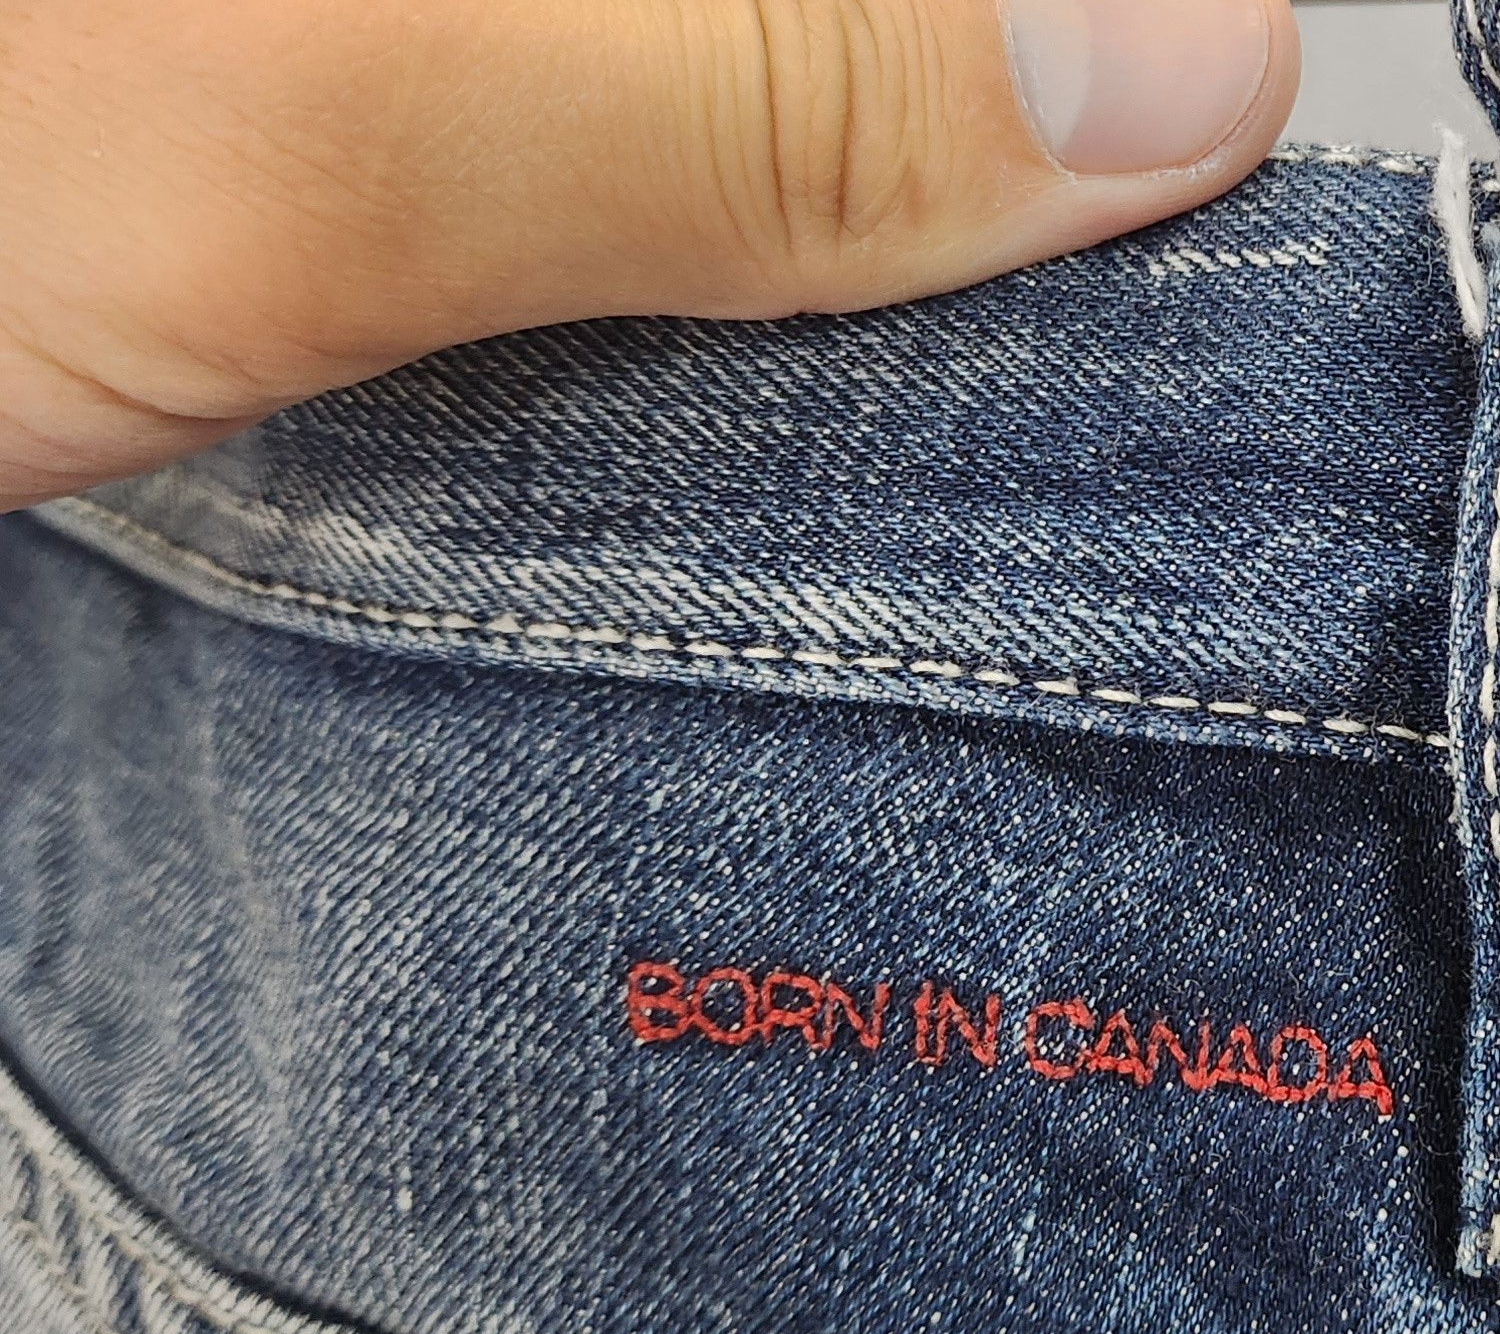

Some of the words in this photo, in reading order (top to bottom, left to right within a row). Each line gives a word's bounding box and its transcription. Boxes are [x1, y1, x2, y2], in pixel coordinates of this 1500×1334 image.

[625, 961, 891, 1051] BORN
[912, 981, 1001, 1068] IN
[1023, 997, 1394, 1116] CANADA
